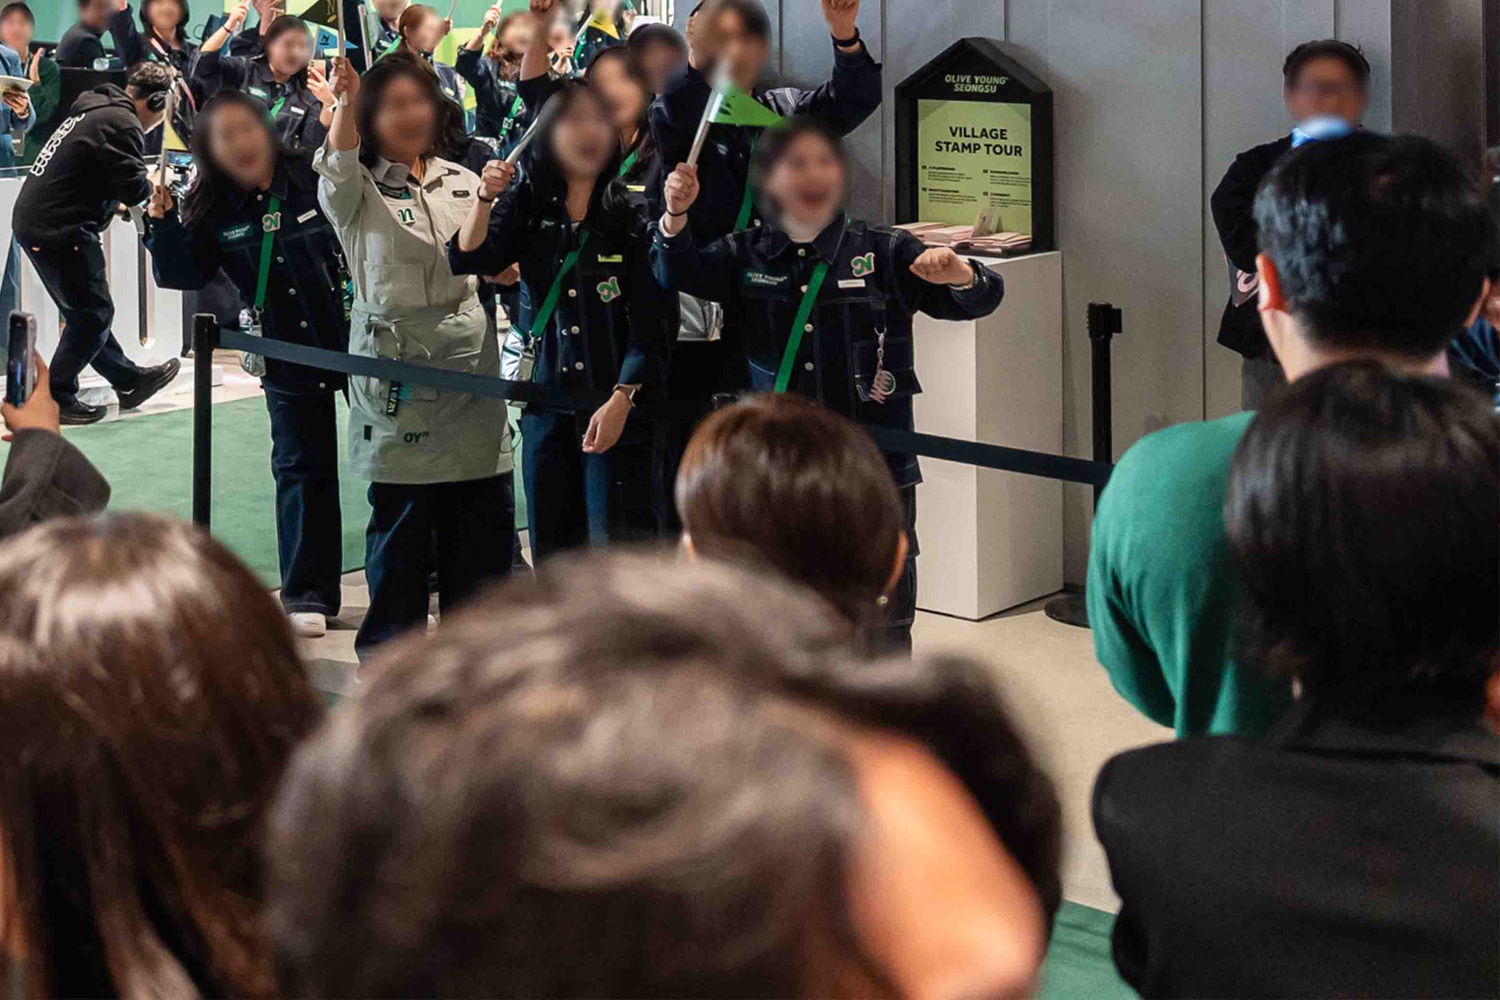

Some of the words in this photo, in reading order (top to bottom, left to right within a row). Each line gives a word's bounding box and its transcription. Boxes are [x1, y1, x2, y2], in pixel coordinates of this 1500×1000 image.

[945, 74, 971, 84] OLIVE
[953, 84, 997, 93] SEONGSU
[949, 126, 1008, 140] VILLAGE
[935, 141, 981, 155] STAMP
[985, 144, 1023, 157] TOUR
